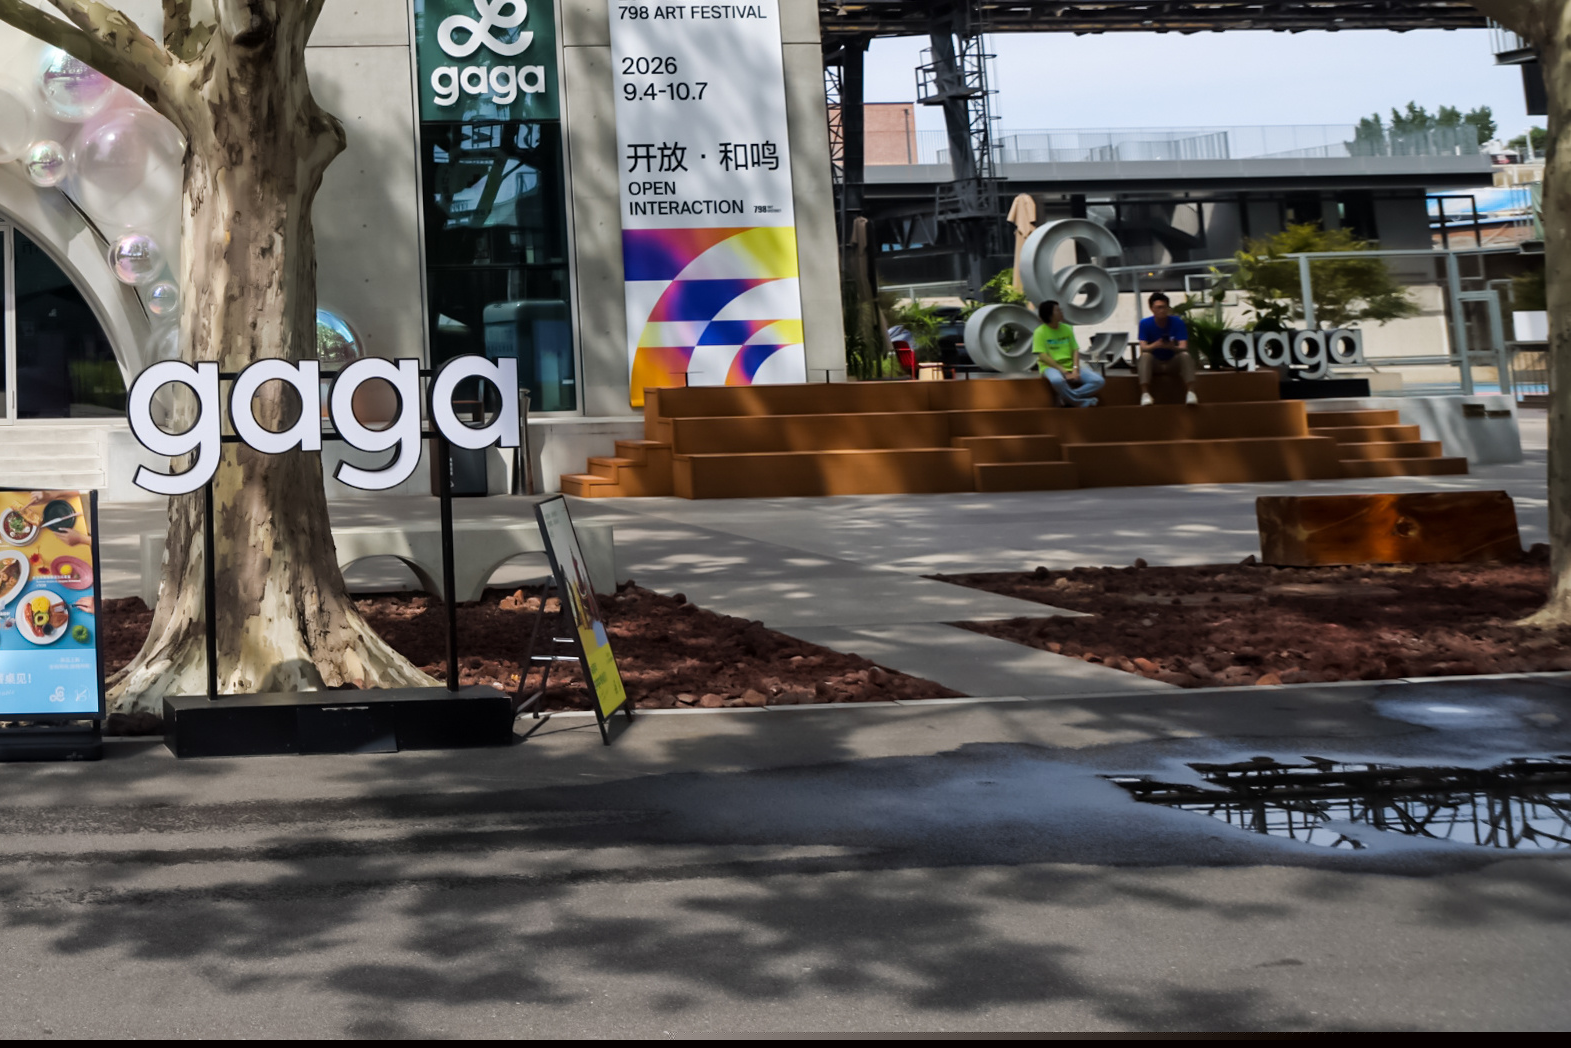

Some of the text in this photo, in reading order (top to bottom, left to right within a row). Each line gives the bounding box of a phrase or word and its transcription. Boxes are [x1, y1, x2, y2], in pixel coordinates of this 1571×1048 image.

[618, 5, 768, 20] 798 ART FESTIVAL
[621, 56, 678, 75] 2026
[430, 64, 546, 106] gaga
[623, 82, 708, 101] 9.4-10.7
[628, 181, 677, 196] OPEN
[629, 199, 744, 216] INTERACTION
[753, 205, 767, 214] 798
[1222, 329, 1364, 380] gaga
[128, 355, 521, 496] gaga
